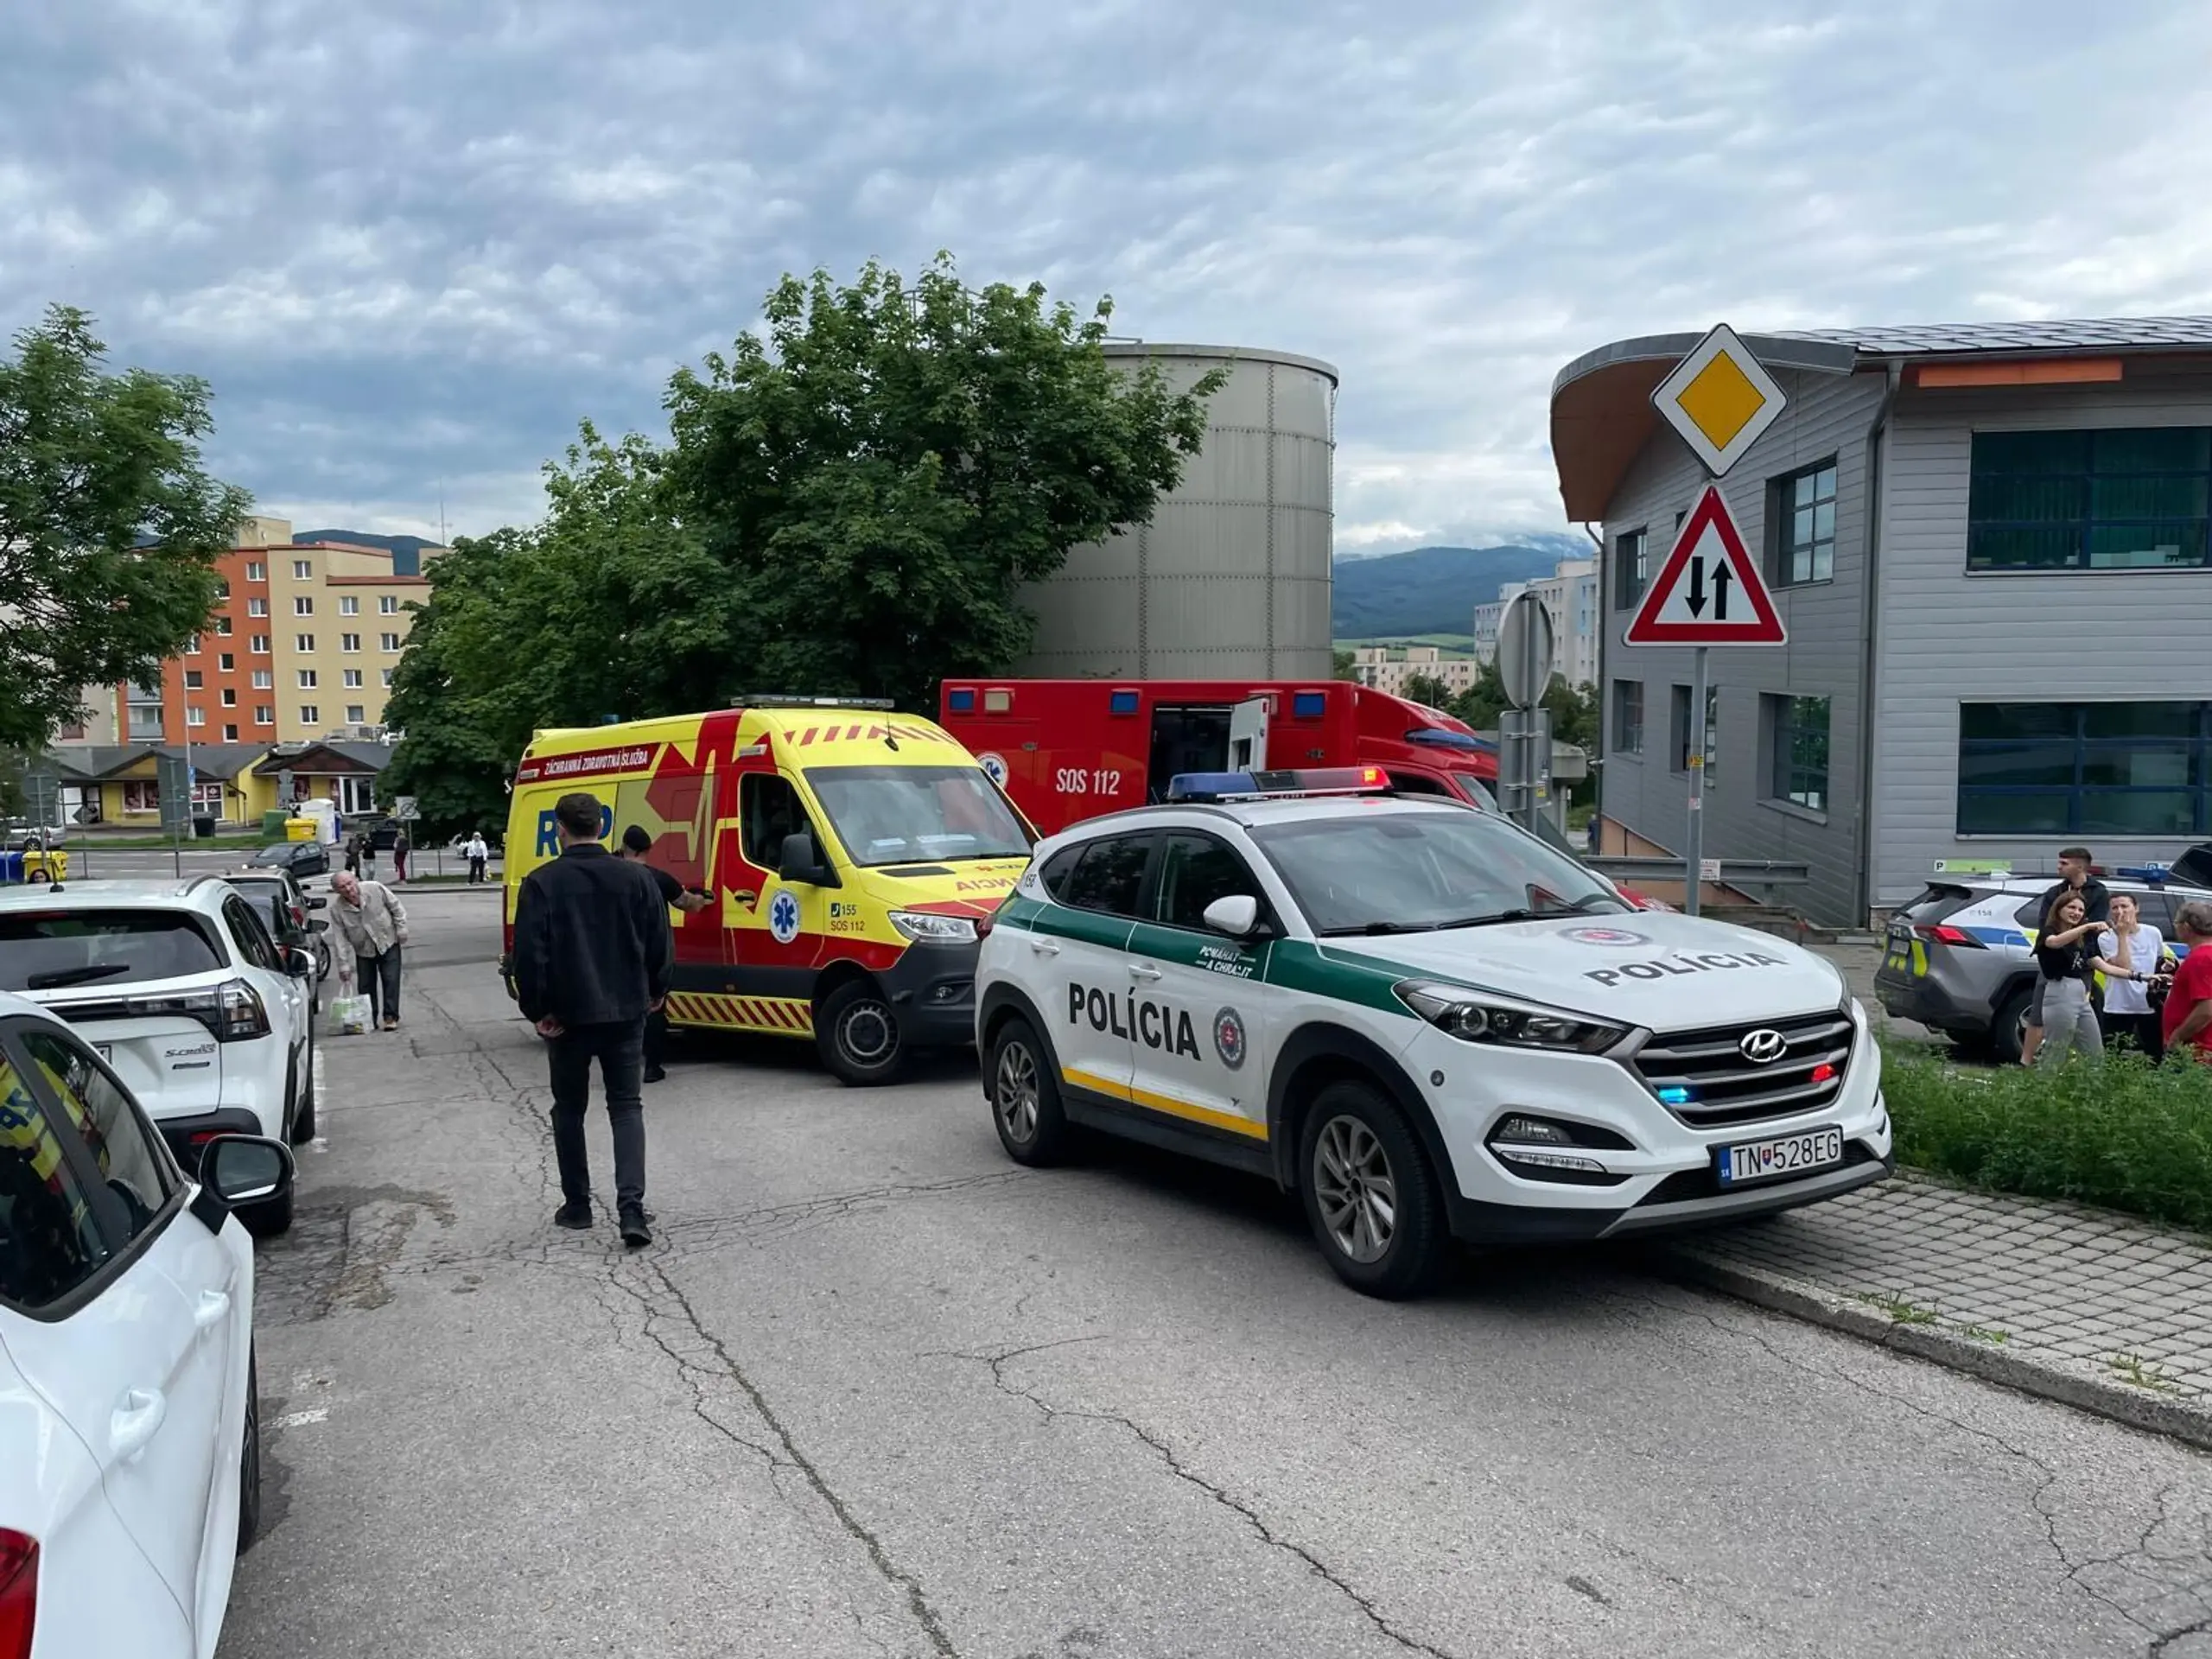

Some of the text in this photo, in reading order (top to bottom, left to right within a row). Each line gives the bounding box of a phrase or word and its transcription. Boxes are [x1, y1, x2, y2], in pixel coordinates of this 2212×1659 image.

[620, 748, 648, 766] SLUŽBA
[1056, 768, 1121, 795] SOS 112
[1936, 861, 1943, 870] P
[842, 904, 857, 916] 155
[830, 920, 866, 931] SOS 112
[1205, 959, 1214, 969] A
[1583, 952, 1789, 987] POLÍCIA
[1069, 982, 1201, 1061] POLÍCIA
